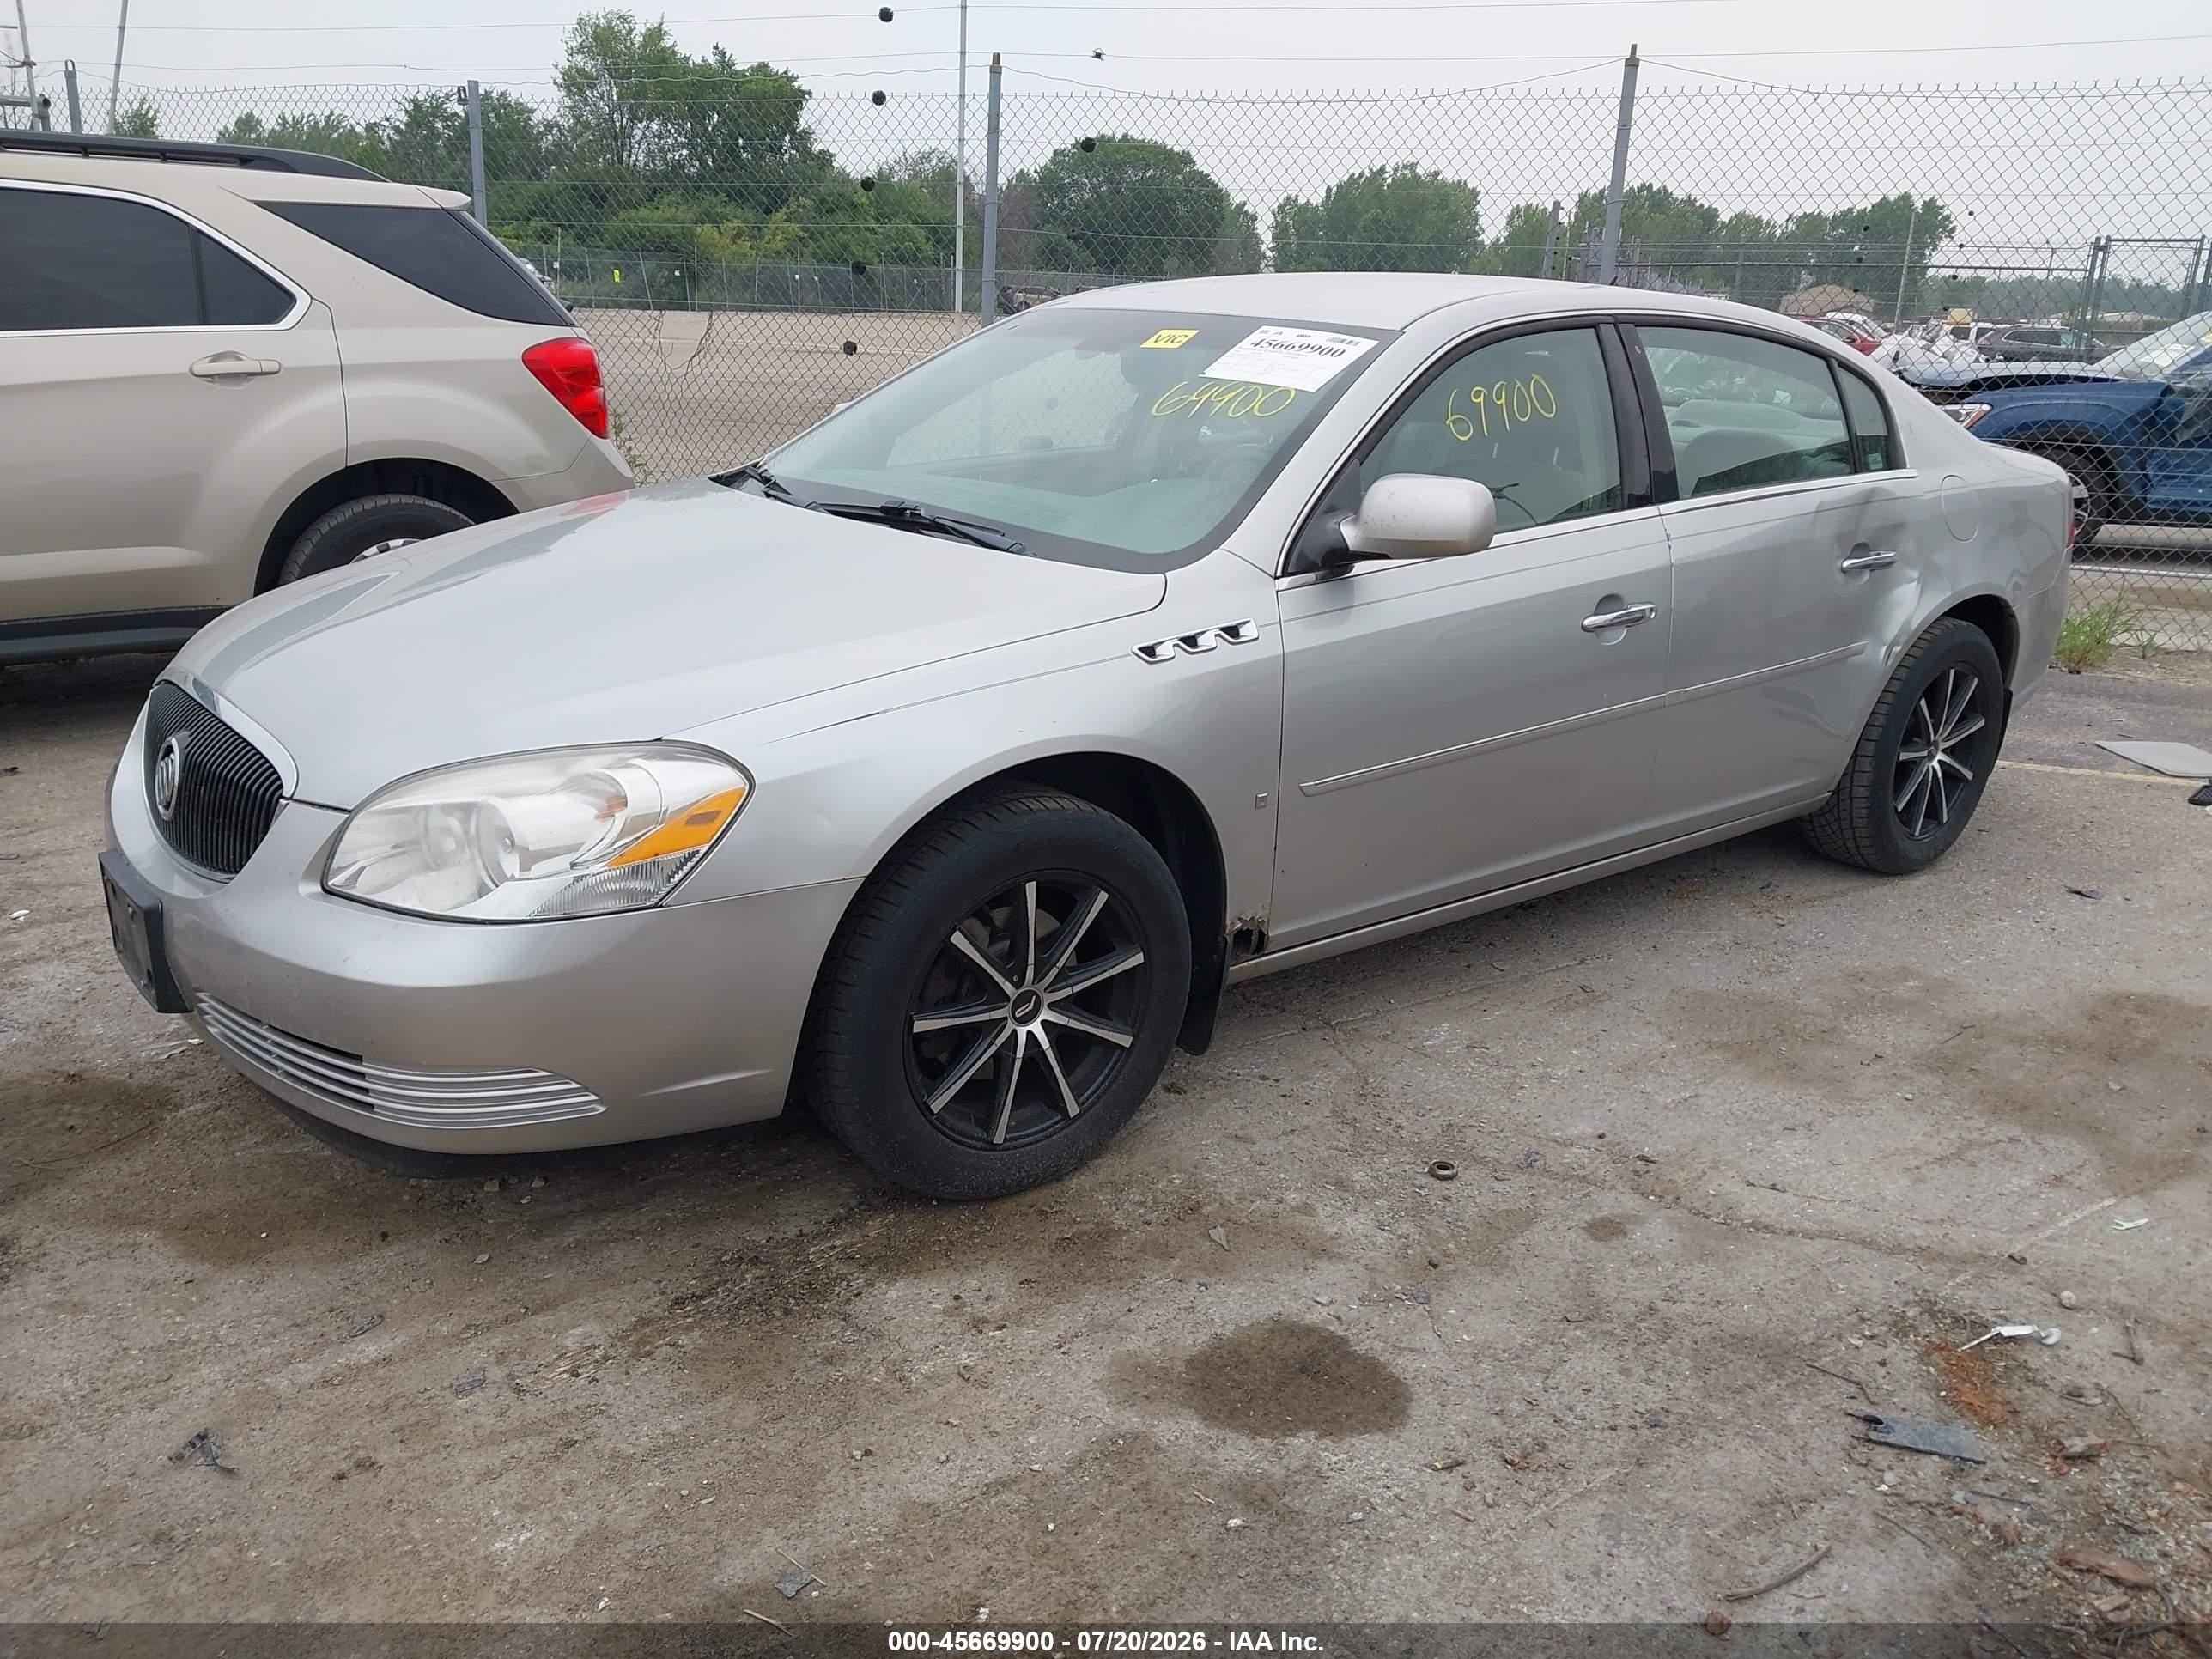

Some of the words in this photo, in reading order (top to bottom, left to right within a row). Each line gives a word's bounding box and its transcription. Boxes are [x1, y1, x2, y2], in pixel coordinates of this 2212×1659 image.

[1153, 334, 1189, 344] VIC
[1250, 337, 1346, 358] 45669900
[1445, 374, 1557, 441] 69900
